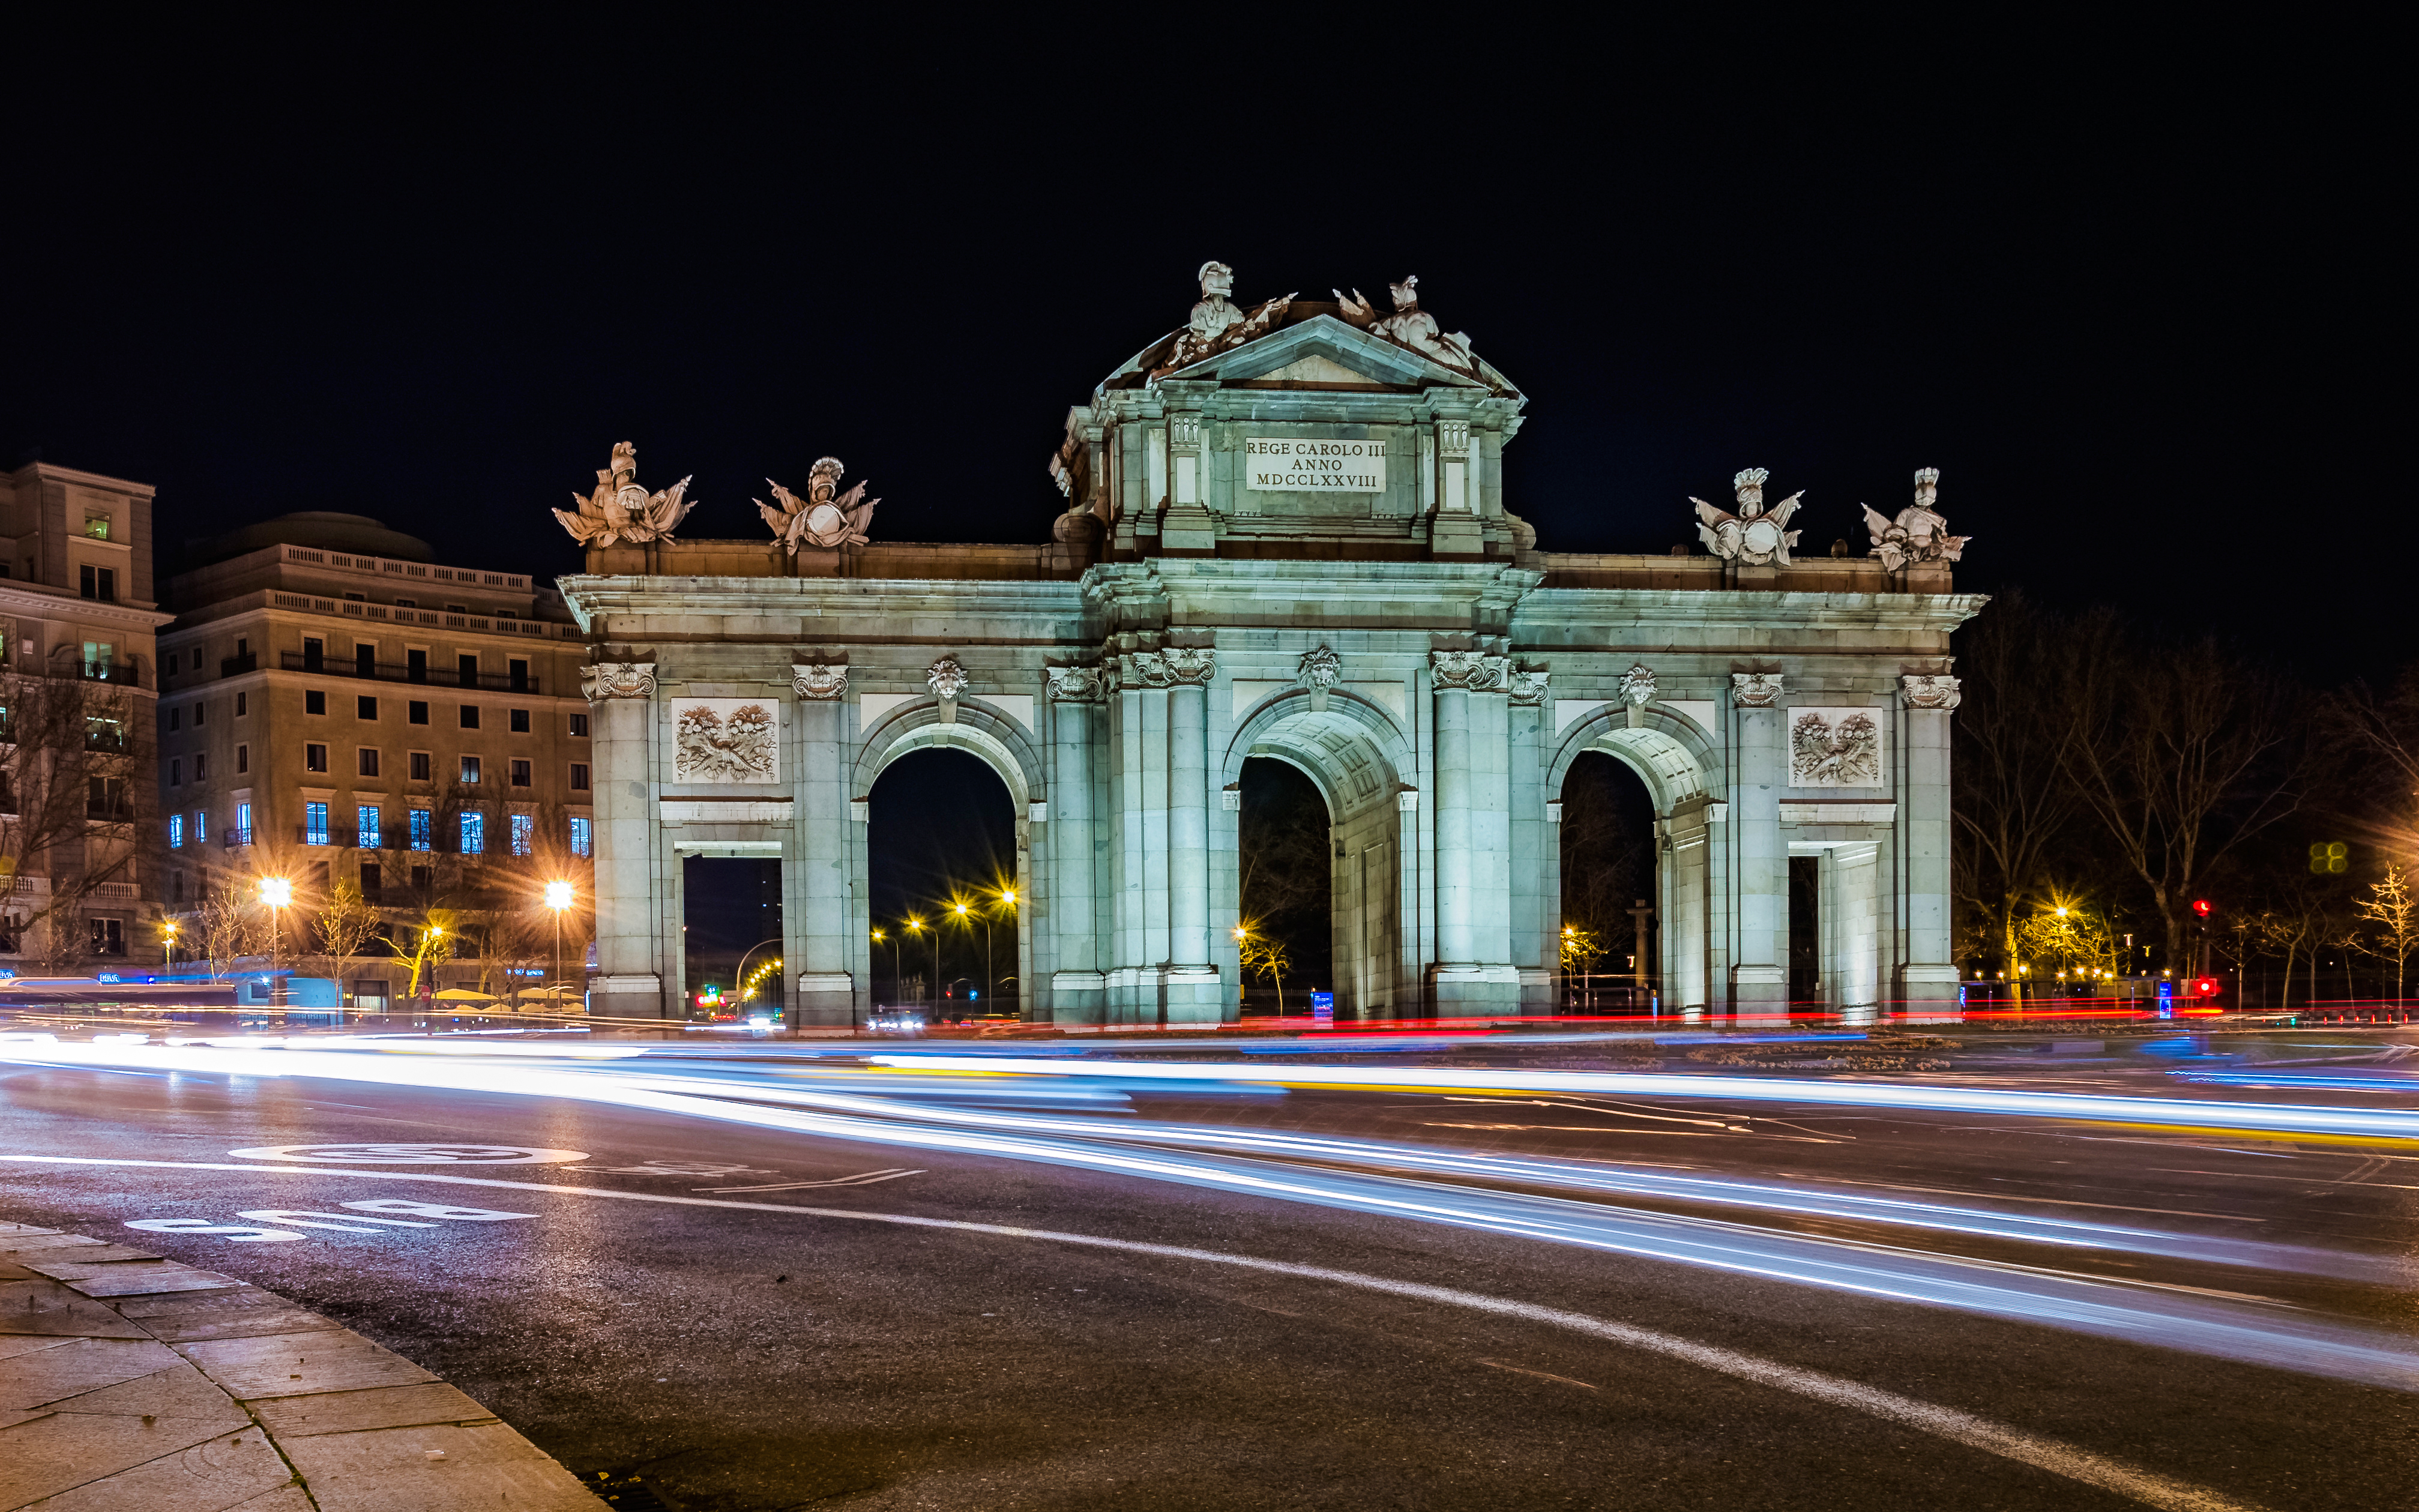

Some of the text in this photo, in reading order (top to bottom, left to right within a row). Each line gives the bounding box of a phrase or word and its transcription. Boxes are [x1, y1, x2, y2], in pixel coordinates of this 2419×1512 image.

[1246, 442, 1386, 457] REGE CAROLO III
[1292, 459, 1342, 471] ANNO
[1257, 474, 1376, 487] MDCCLXXVIII
[124, 1199, 542, 1242] BUS
